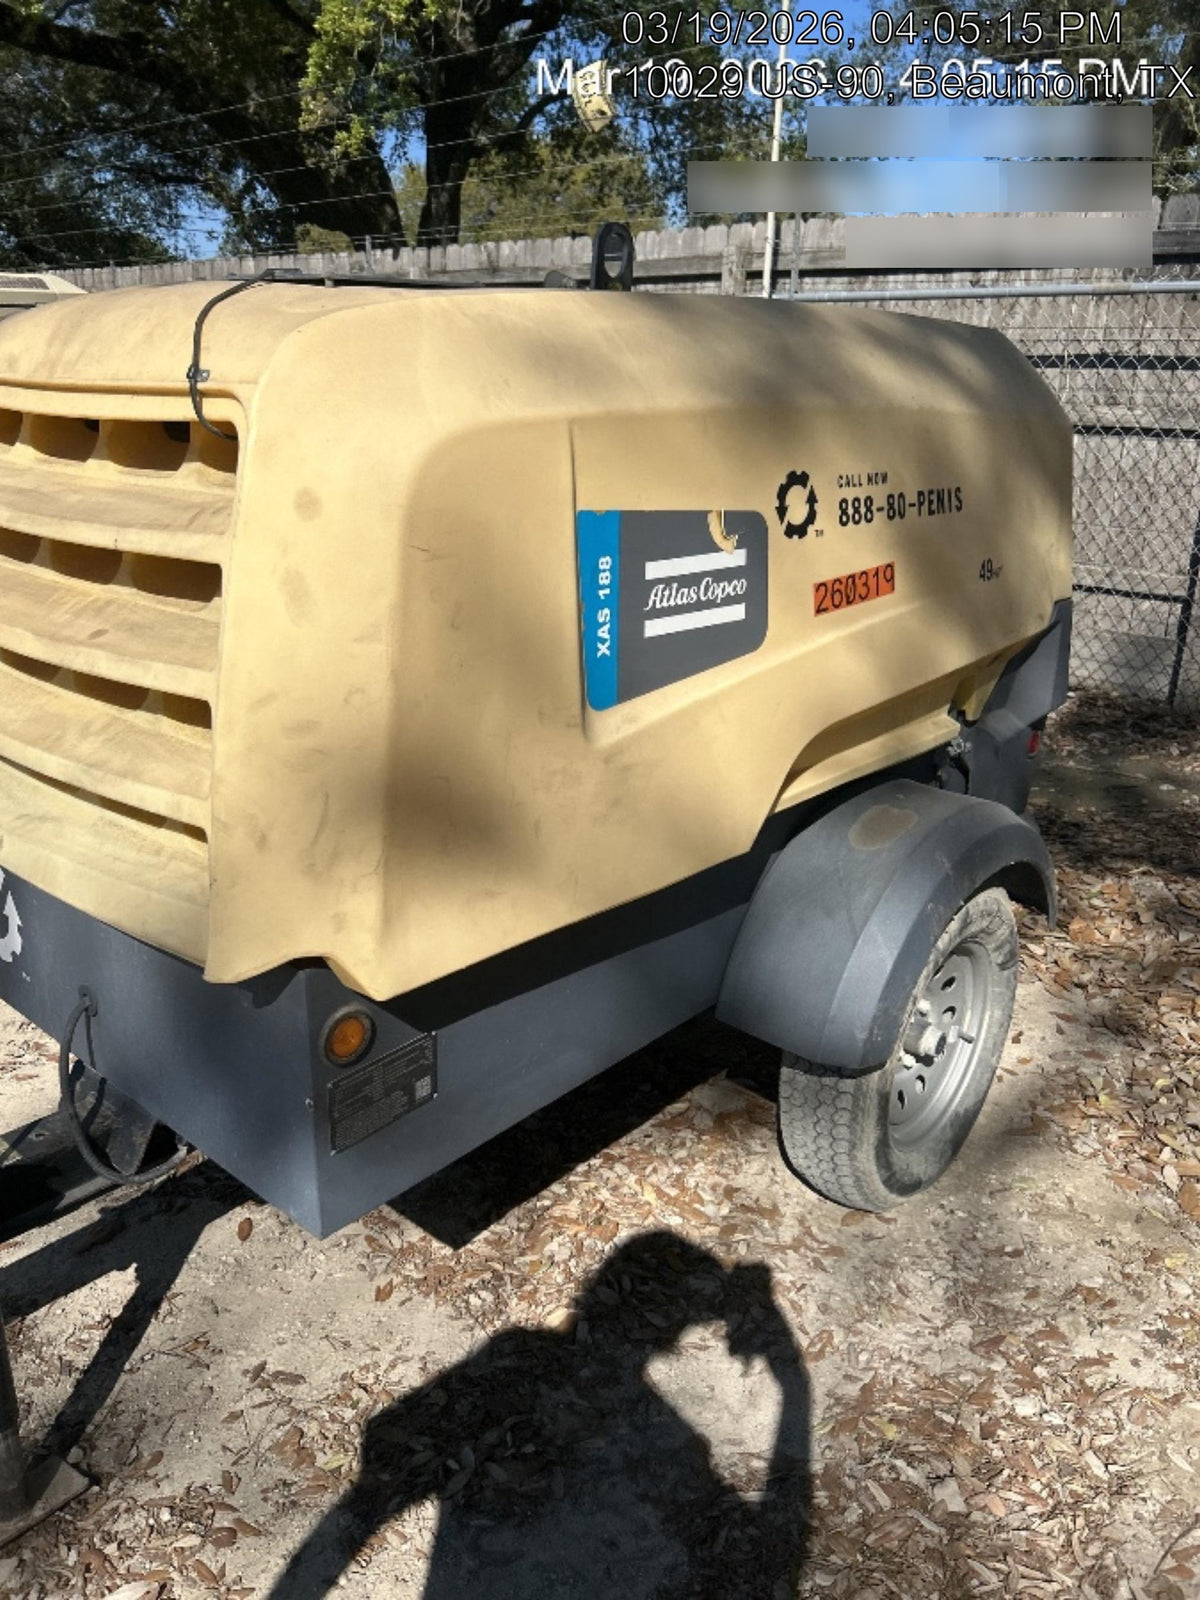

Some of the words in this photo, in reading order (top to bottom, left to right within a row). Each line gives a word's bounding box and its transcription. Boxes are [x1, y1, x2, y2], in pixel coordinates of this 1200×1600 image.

[837, 474, 863, 488] CALL
[867, 472, 888, 487] NOW
[838, 486, 963, 527] 888-80-PENIS
[598, 555, 612, 600] 188
[644, 580, 698, 611] Atlas
[699, 576, 747, 603] Copco
[815, 563, 895, 615] 260319
[597, 607, 611, 658] XAS
